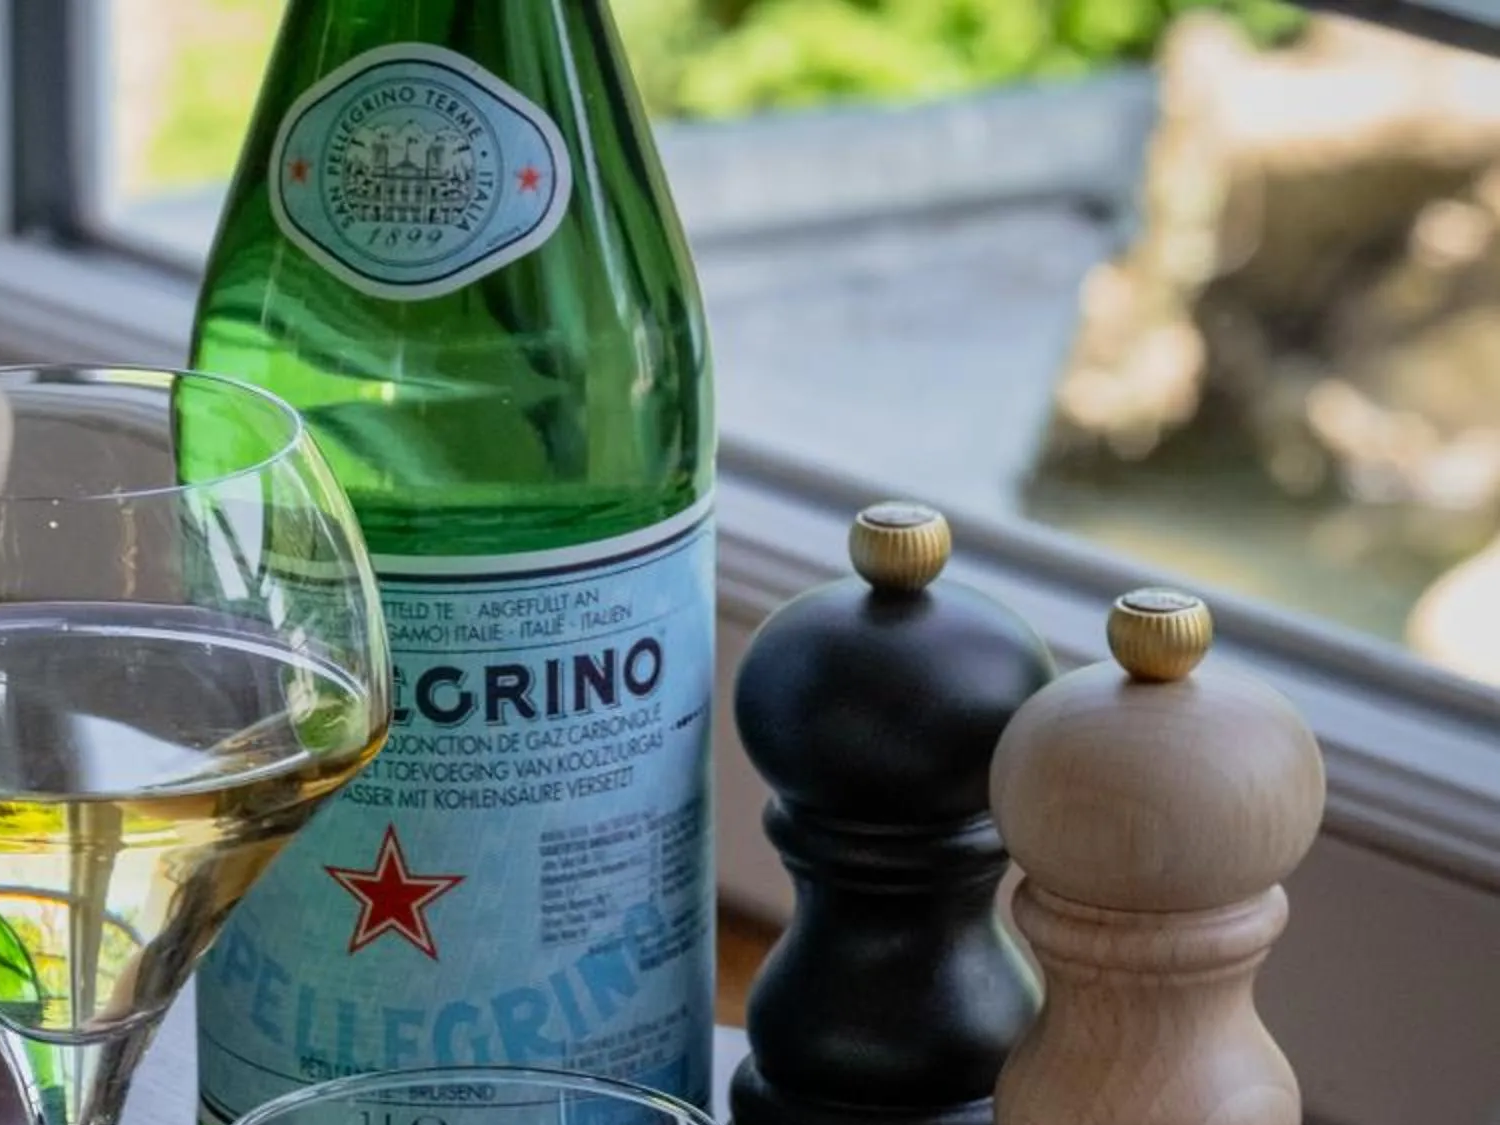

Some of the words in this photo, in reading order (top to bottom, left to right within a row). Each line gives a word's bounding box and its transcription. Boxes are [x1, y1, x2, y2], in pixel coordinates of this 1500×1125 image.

[327, 86, 416, 176] PELLEGRINO
[425, 88, 485, 142] TERME
[456, 171, 494, 232] ITALIA
[575, 586, 600, 608] AN
[393, 636, 663, 728] GRINO
[384, 733, 492, 755] DJONCTION
[498, 732, 521, 753] DE
[525, 727, 563, 750] GAZ
[386, 760, 509, 783] TOEVOEGING
[515, 757, 553, 778] VAN
[399, 788, 431, 809] MIT
